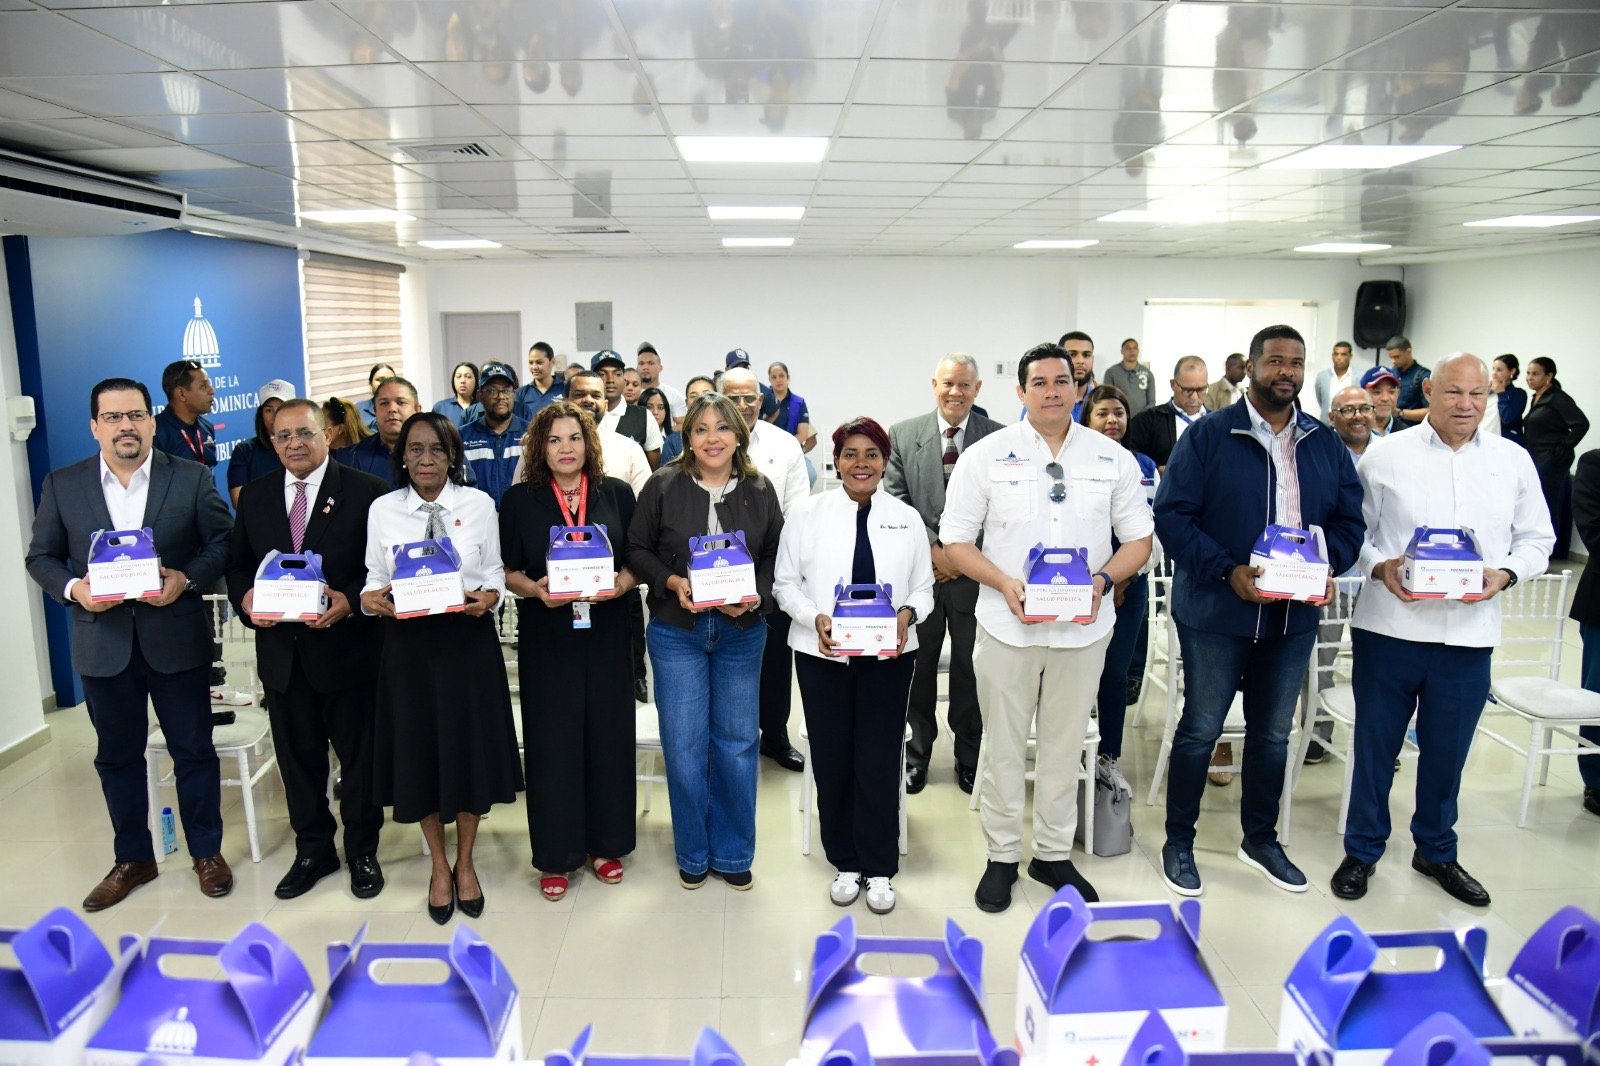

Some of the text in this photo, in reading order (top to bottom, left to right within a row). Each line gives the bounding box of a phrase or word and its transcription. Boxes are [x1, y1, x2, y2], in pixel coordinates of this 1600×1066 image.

[214, 376, 227, 389] DE
[228, 374, 240, 388] LA
[1138, 374, 1148, 390] 3
[209, 391, 260, 415] OMINICA
